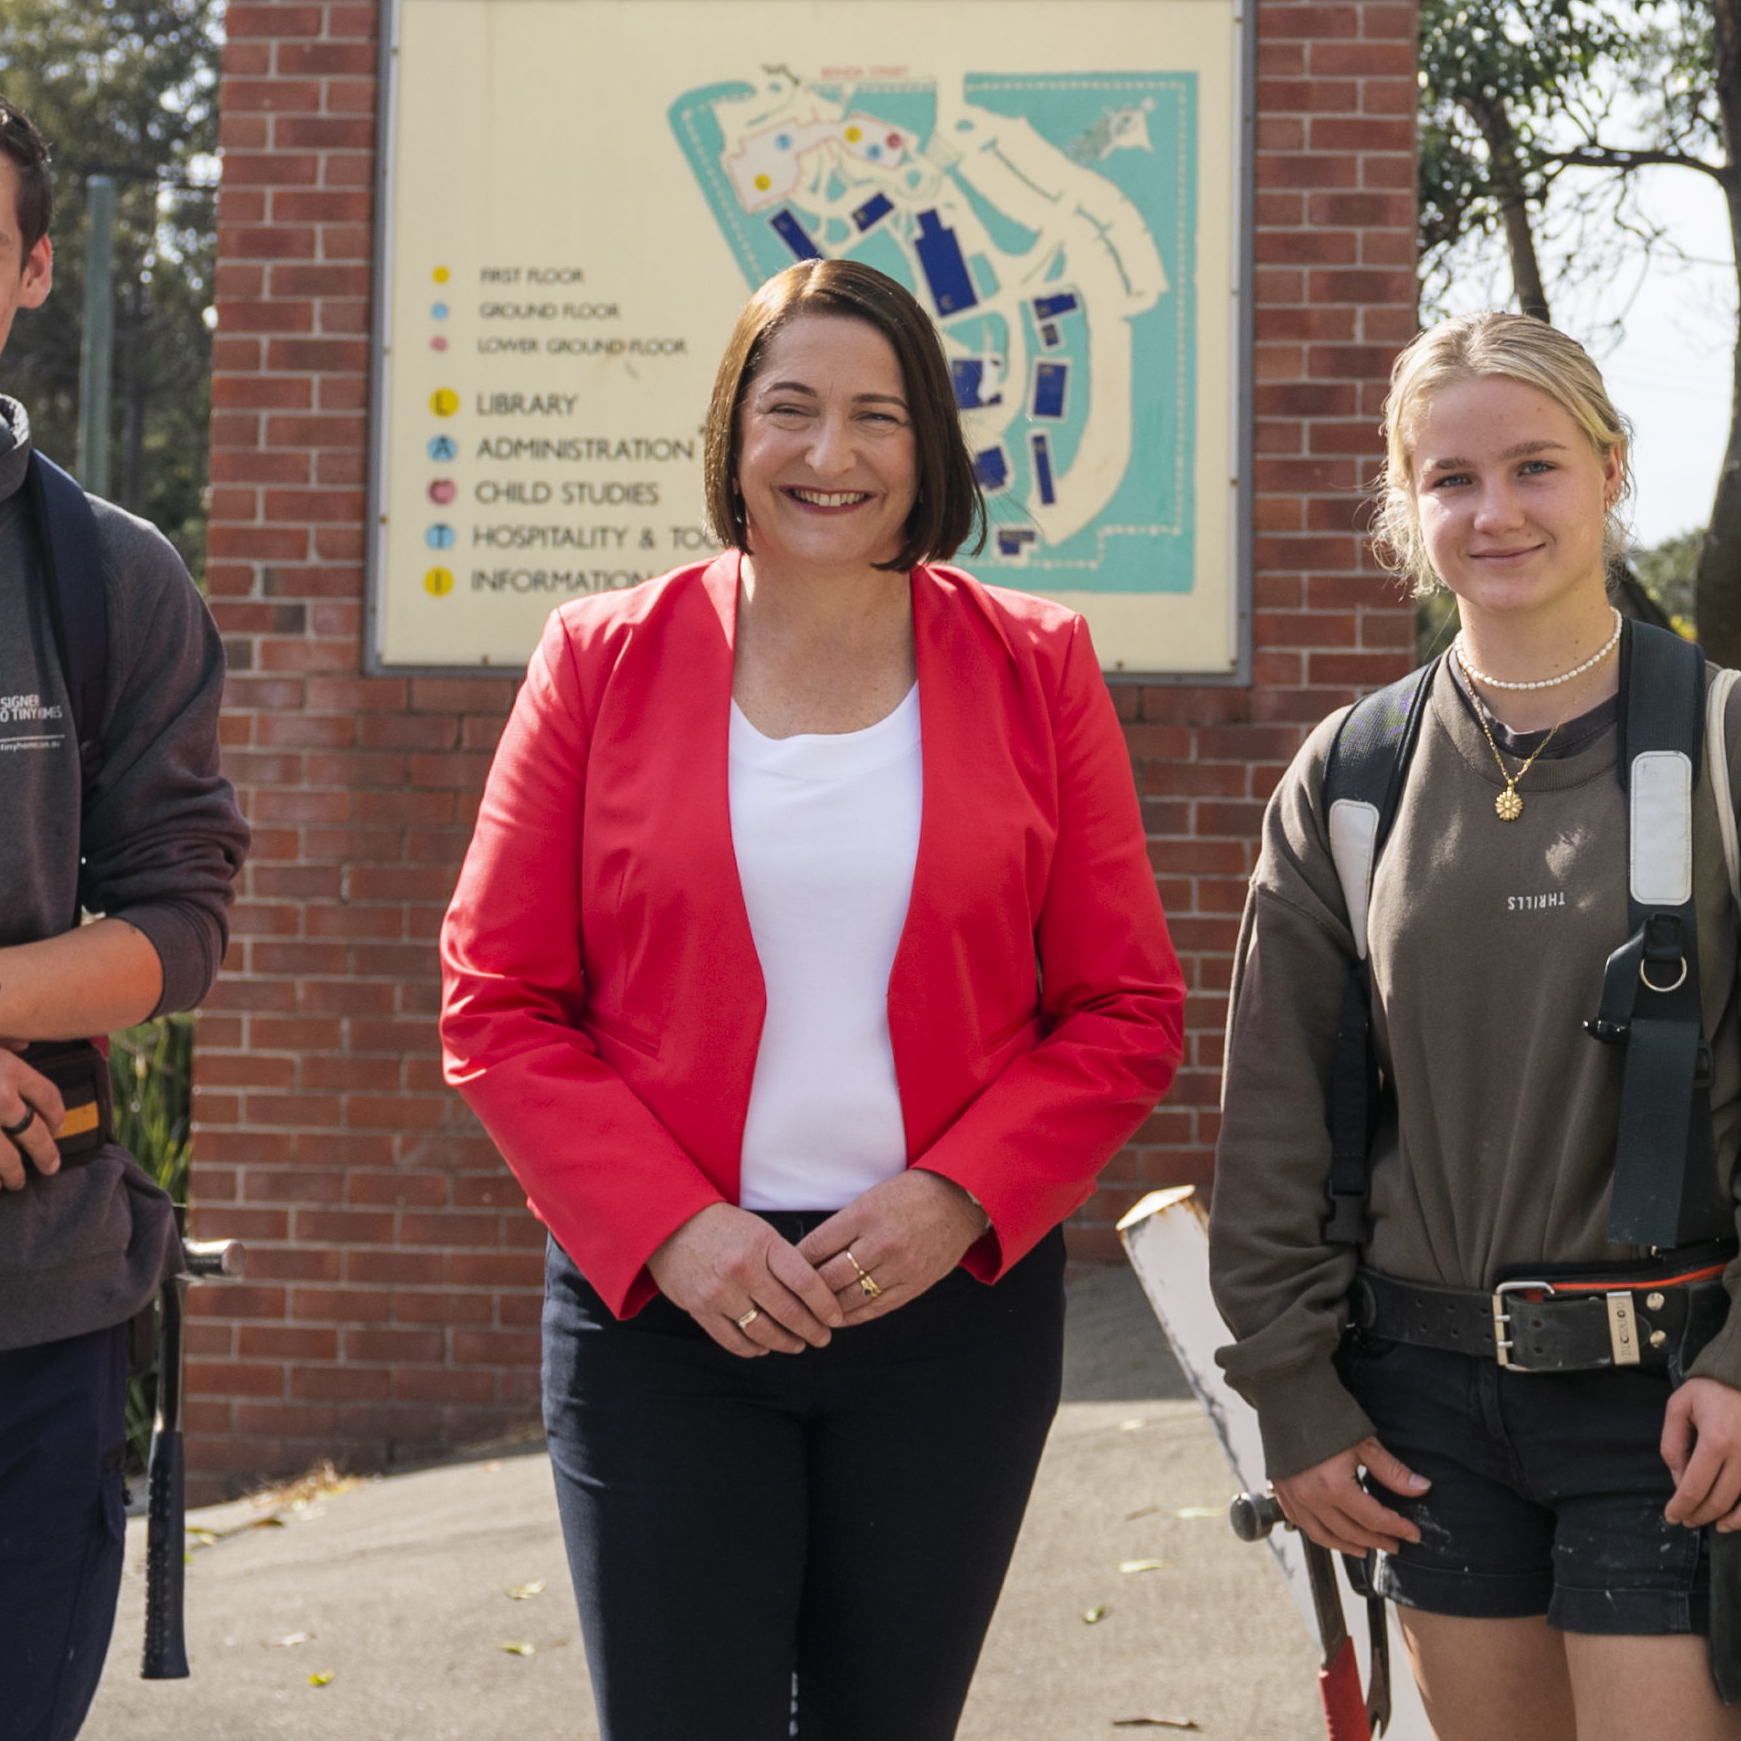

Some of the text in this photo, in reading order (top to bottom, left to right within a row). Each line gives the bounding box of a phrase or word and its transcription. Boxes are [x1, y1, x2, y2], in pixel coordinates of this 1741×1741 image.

[479, 267, 584, 284] FIRST FLOOR
[479, 302, 620, 320] GROUND FLOOR
[477, 337, 686, 356] LOWER GROUND FLOOR
[434, 393, 578, 416] L LIBRARY
[433, 437, 694, 461] A ADMINISTRATION
[474, 480, 552, 505] CHILD
[562, 480, 659, 506] STUDIES
[472, 524, 629, 549] HOSPITALITY
[639, 526, 655, 549] &
[12, 707, 37, 721] TINY
[1507, 892, 1565, 910] THRILLS
